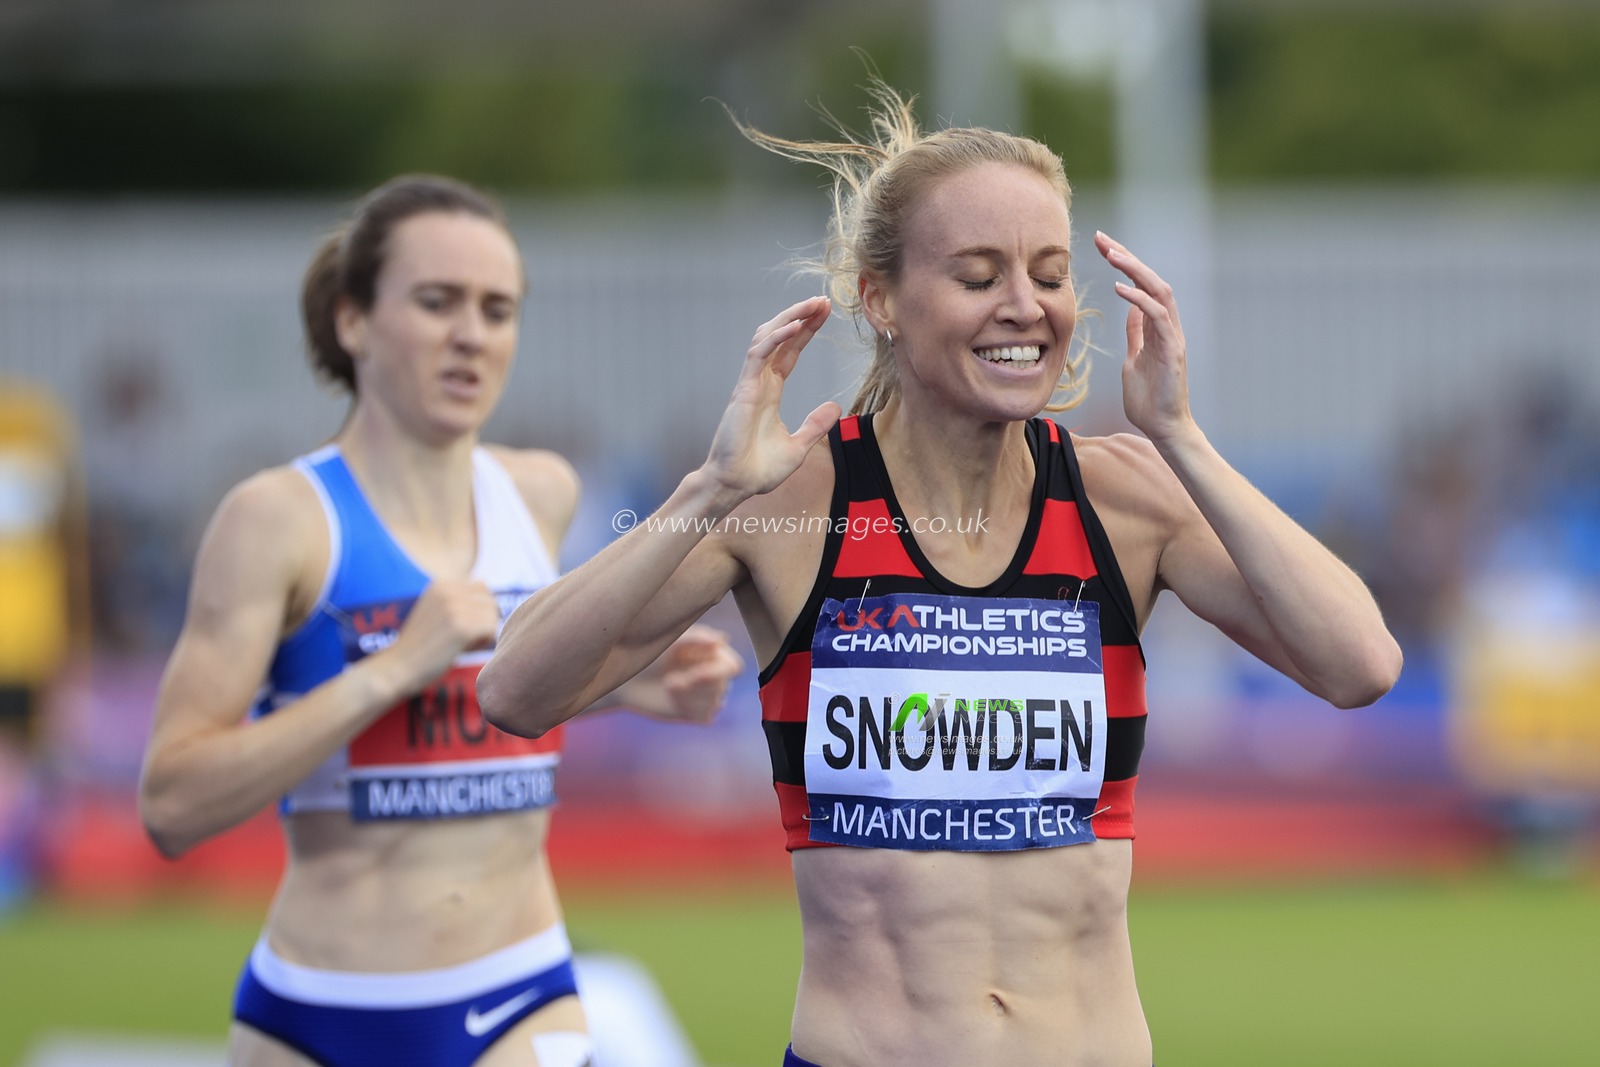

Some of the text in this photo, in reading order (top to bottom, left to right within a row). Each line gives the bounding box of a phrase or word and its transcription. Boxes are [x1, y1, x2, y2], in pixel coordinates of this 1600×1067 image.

[836, 604, 1085, 633] UK ATHLETICS
[831, 632, 1087, 658] CHAMPIONSHIPS
[822, 694, 1092, 772] SNOWDEN
[832, 802, 1077, 840] MANCHESTER
